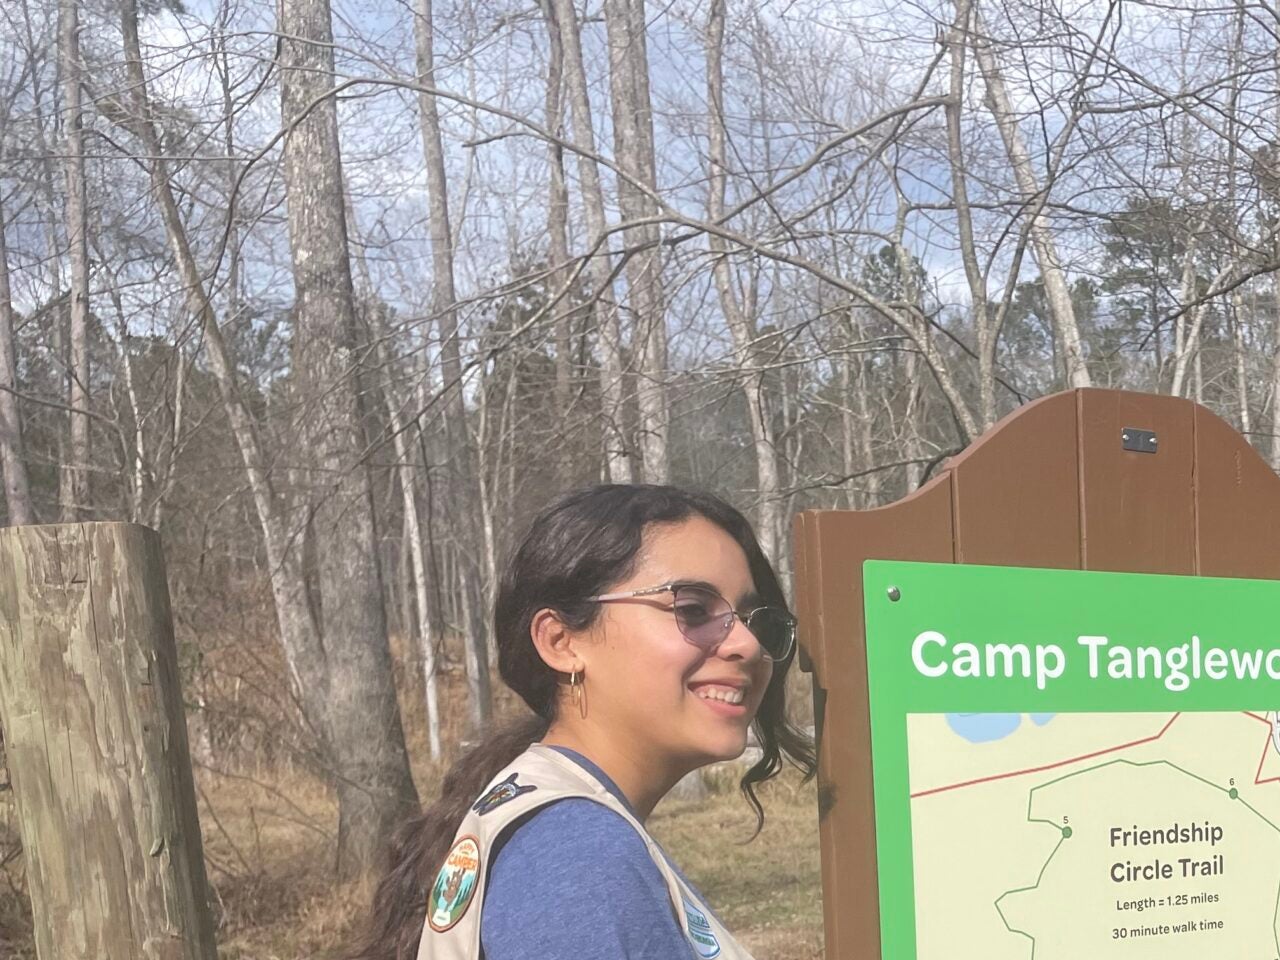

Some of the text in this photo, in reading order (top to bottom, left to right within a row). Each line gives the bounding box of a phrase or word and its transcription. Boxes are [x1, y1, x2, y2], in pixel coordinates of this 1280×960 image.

[911, 631, 1066, 690] Camp
[1229, 777, 1235, 786] 6
[1063, 816, 1069, 824] 5
[1110, 821, 1223, 847] Friendship
[1110, 855, 1223, 882] Circle Trail
[1116, 892, 1219, 912] Length = 1.25 miles
[1112, 920, 1224, 939] 30 minute walk time
